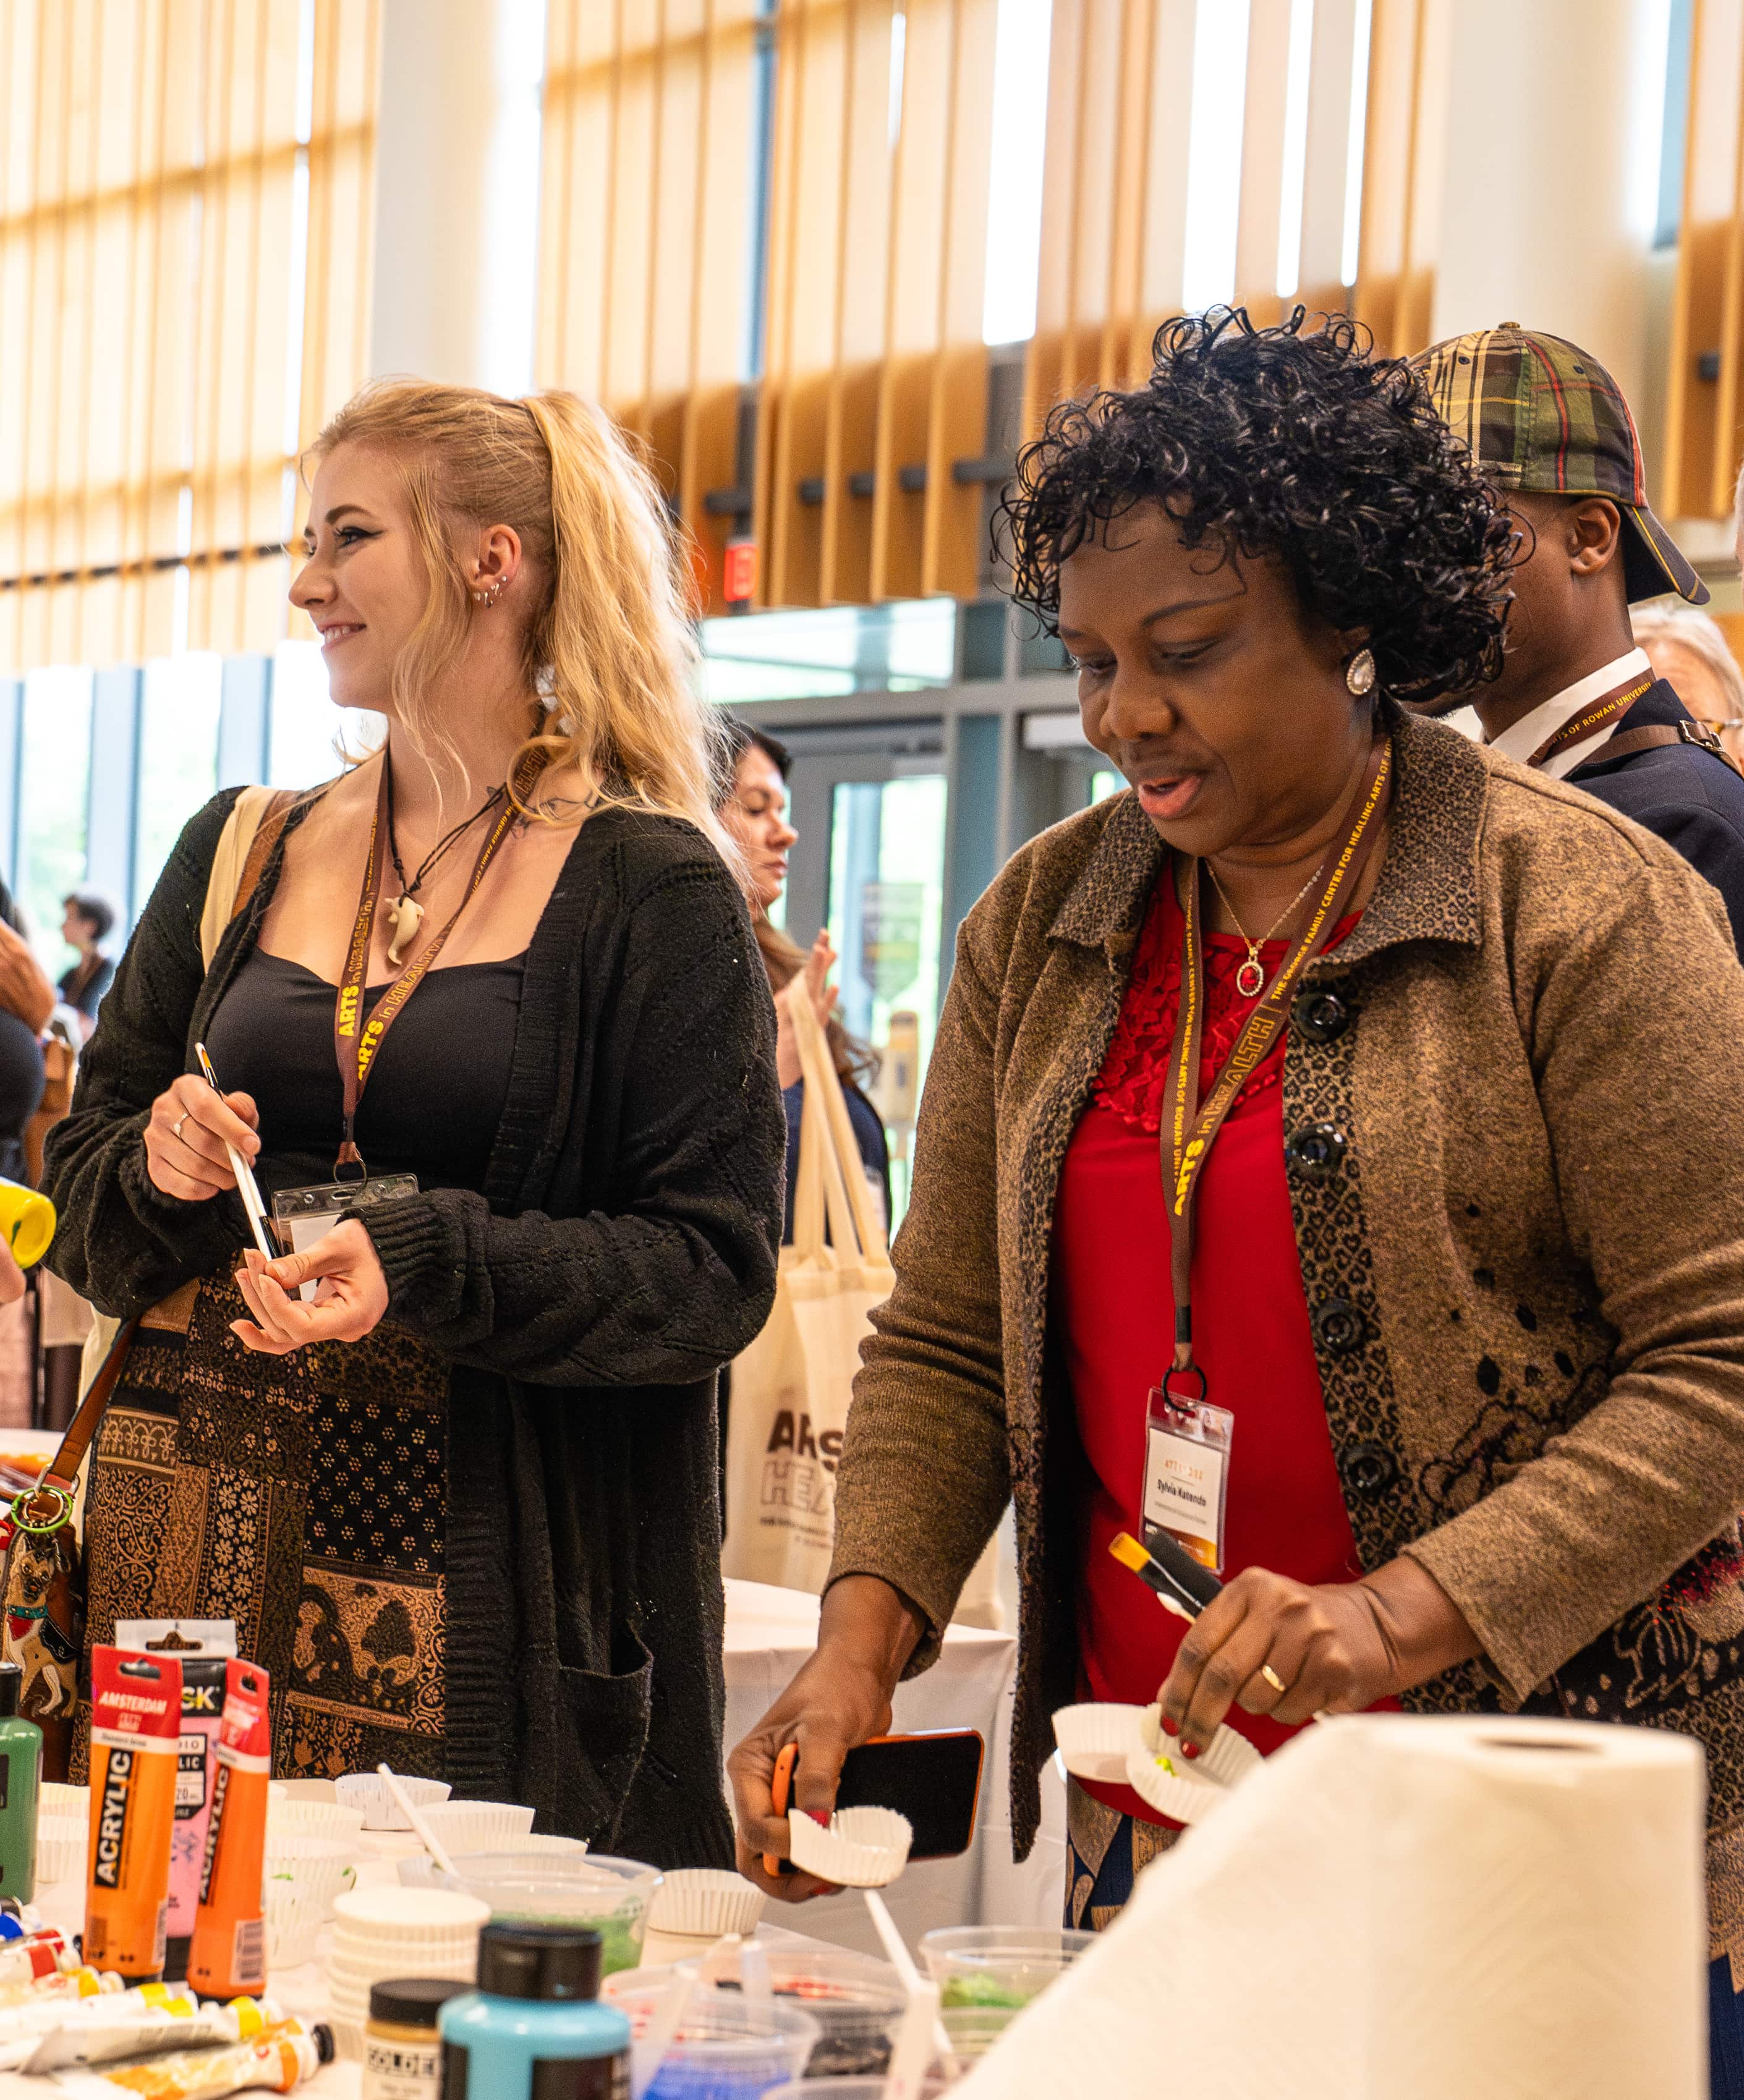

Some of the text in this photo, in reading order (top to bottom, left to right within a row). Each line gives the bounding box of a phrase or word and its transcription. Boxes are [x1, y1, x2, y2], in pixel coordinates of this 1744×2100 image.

[1568, 723, 1580, 734] OF
[1583, 703, 1616, 727] ROWAN
[1270, 980, 1288, 1000] THE
[1304, 908, 1327, 945] FAMILY
[1321, 868, 1345, 908] CENTER
[1338, 846, 1356, 869] FOR
[1348, 801, 1376, 846] HEALING
[1370, 775, 1386, 801] ARTS
[1379, 759, 1392, 775] OF
[338, 985, 360, 1037] ARTS
[379, 1005, 396, 1019] in
[1173, 1105, 1185, 1146] ROWAN
[1197, 1117, 1215, 1134] in
[98, 1691, 168, 1715] AMSTERDAM
[96, 1751, 130, 1885] ACRYLIC
